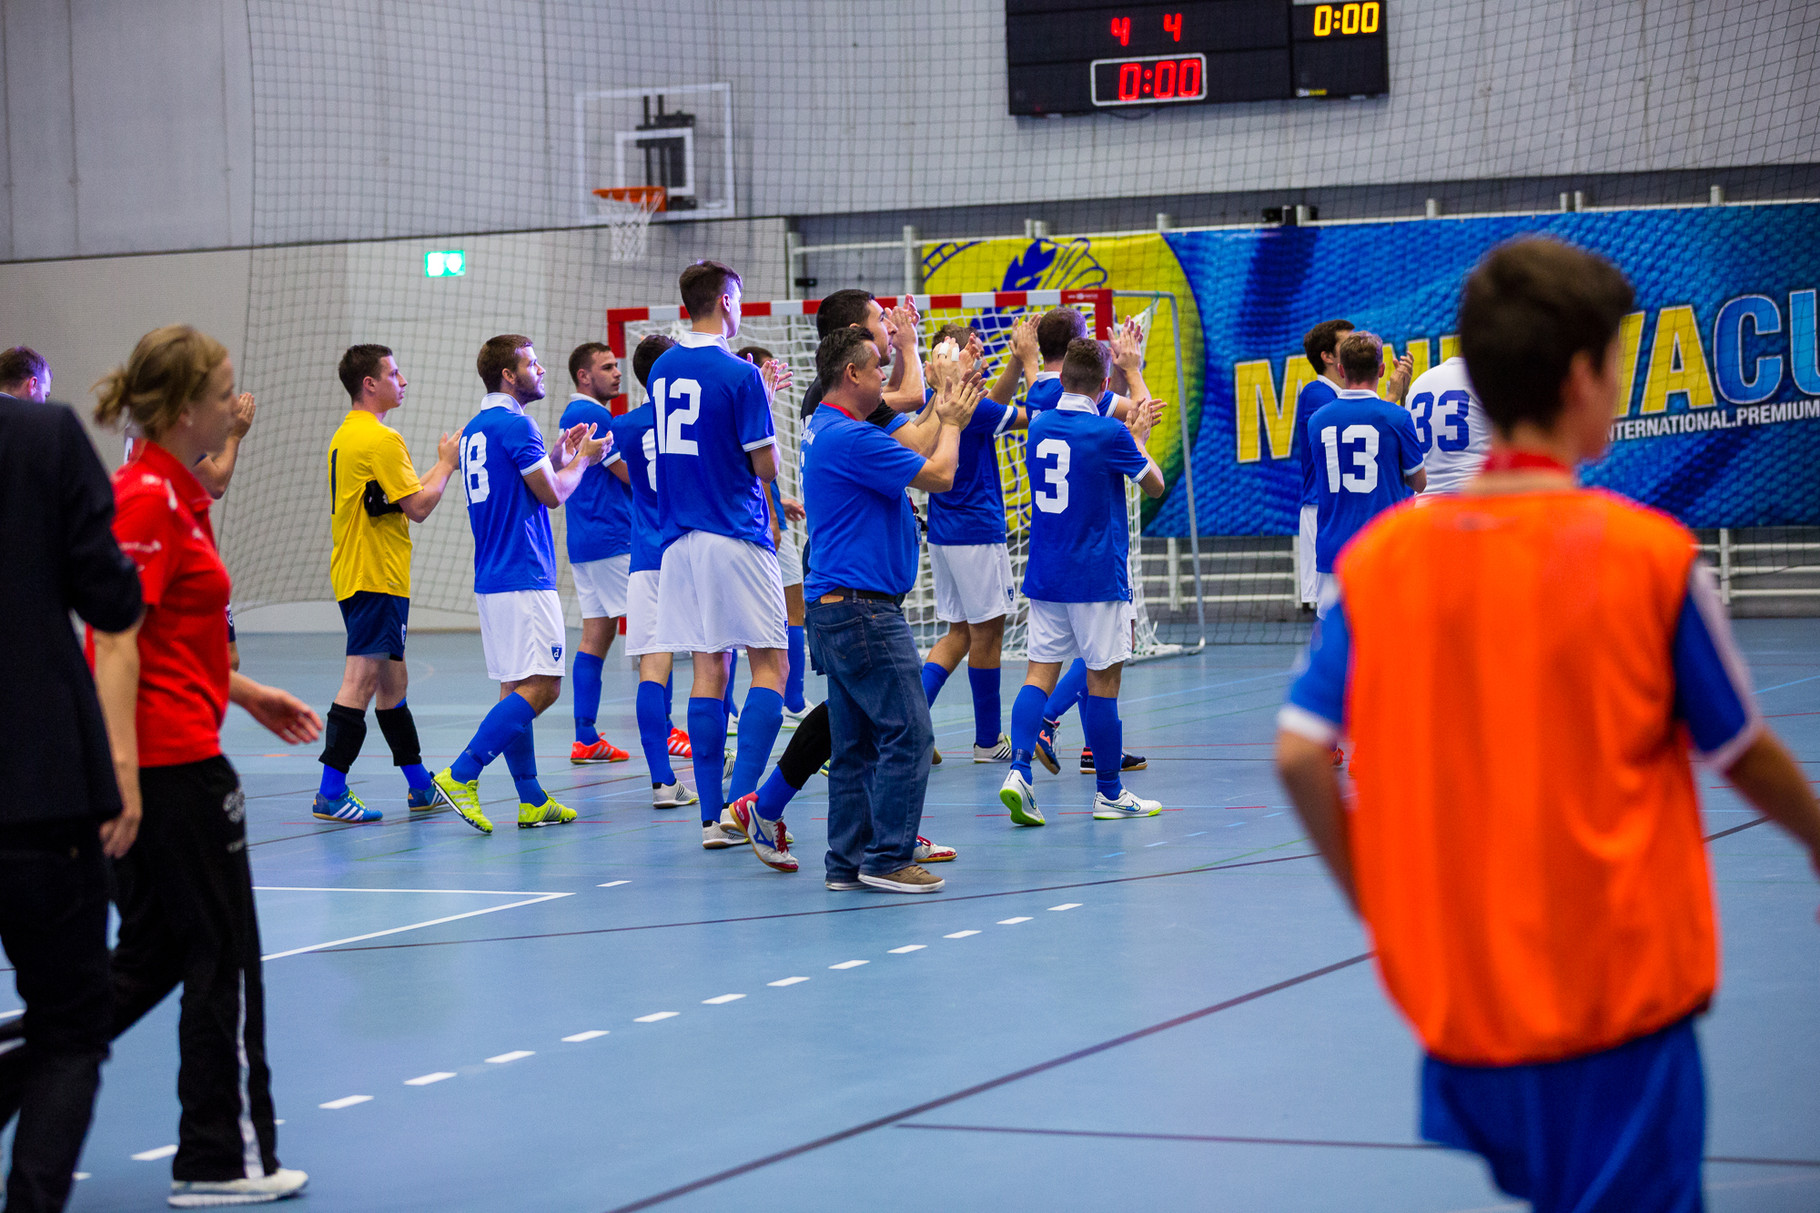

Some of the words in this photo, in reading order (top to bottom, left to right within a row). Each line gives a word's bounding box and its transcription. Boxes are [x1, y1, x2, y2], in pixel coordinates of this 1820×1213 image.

[1111, 17, 1131, 46] 4
[1163, 13, 1182, 42] 4
[1314, 2, 1379, 36] 0:00
[1118, 59, 1201, 102] 0:00
[652, 377, 701, 456] 12
[1411, 389, 1470, 452] 33
[459, 431, 490, 507] 18
[1036, 438, 1070, 514] 3
[1321, 424, 1379, 493] 13
